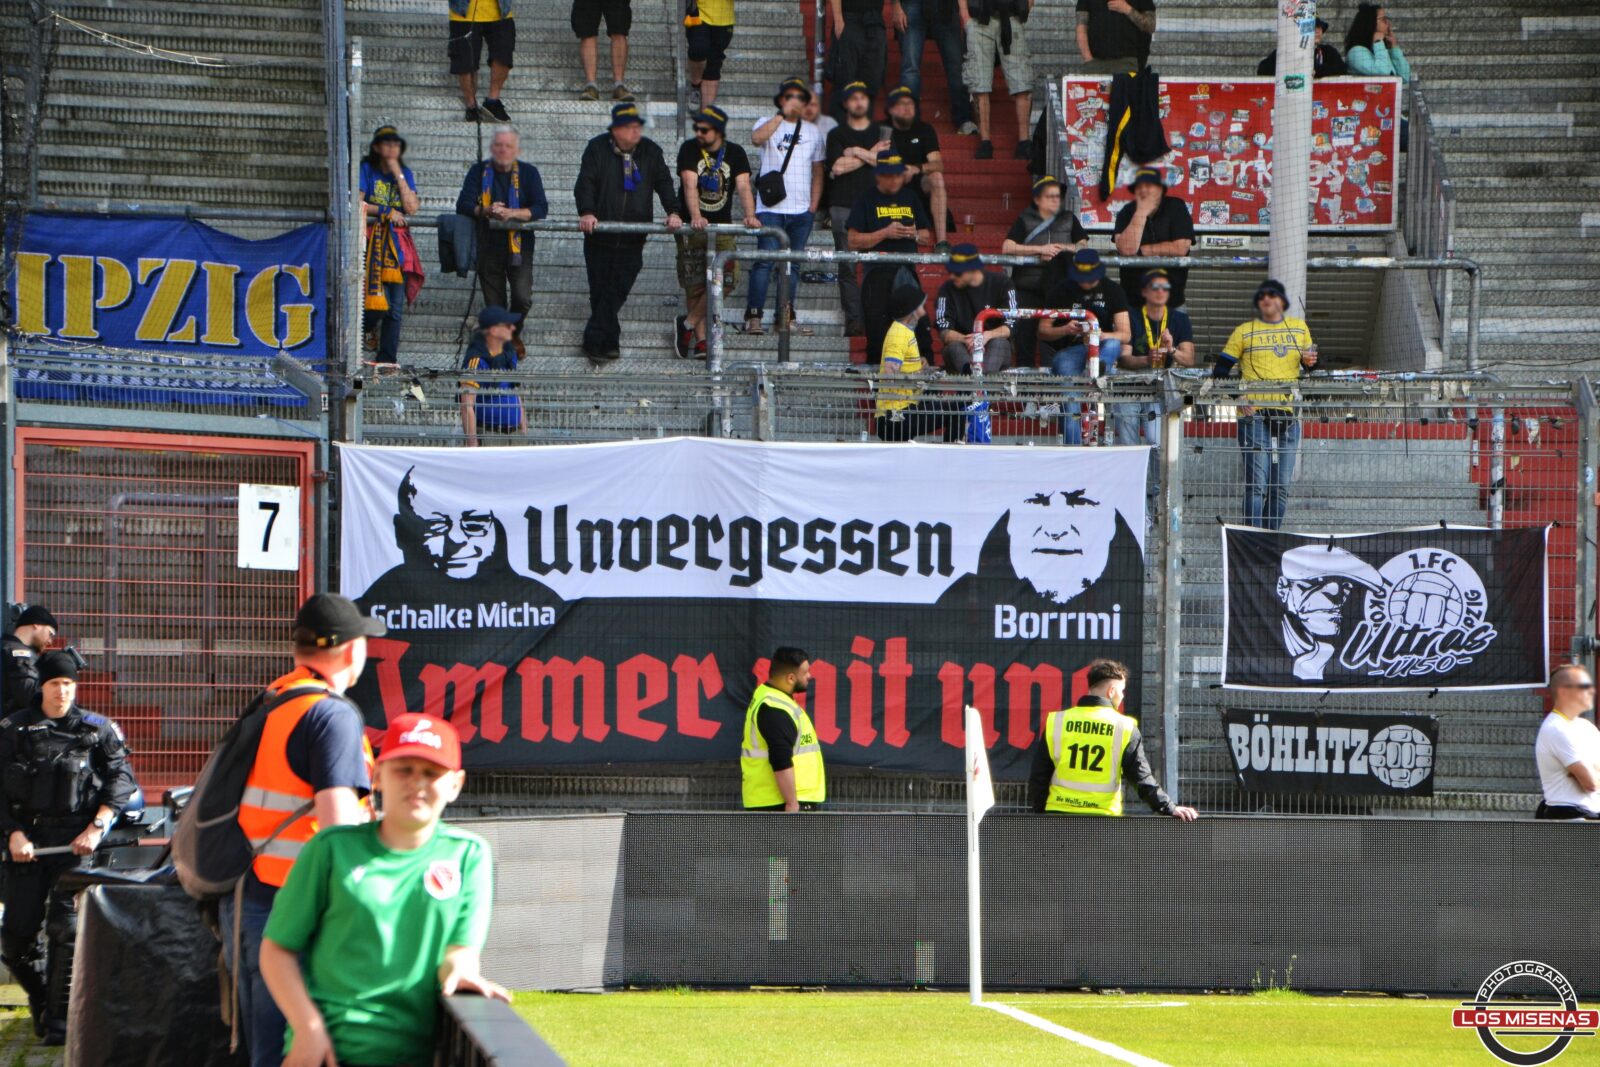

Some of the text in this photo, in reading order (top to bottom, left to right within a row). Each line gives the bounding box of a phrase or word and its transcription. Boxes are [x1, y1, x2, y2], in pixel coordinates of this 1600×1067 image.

[258, 501, 280, 553] 7
[523, 504, 955, 588] Unvergessen
[370, 601, 556, 630] Schalke Micha
[994, 603, 1121, 640] Borrmi
[1340, 620, 1498, 670] Ultras
[938, 661, 1125, 750] un
[1066, 720, 1114, 737] ORDNER
[1067, 742, 1106, 772] 112
[1228, 714, 1370, 775] BÖHLITZ
